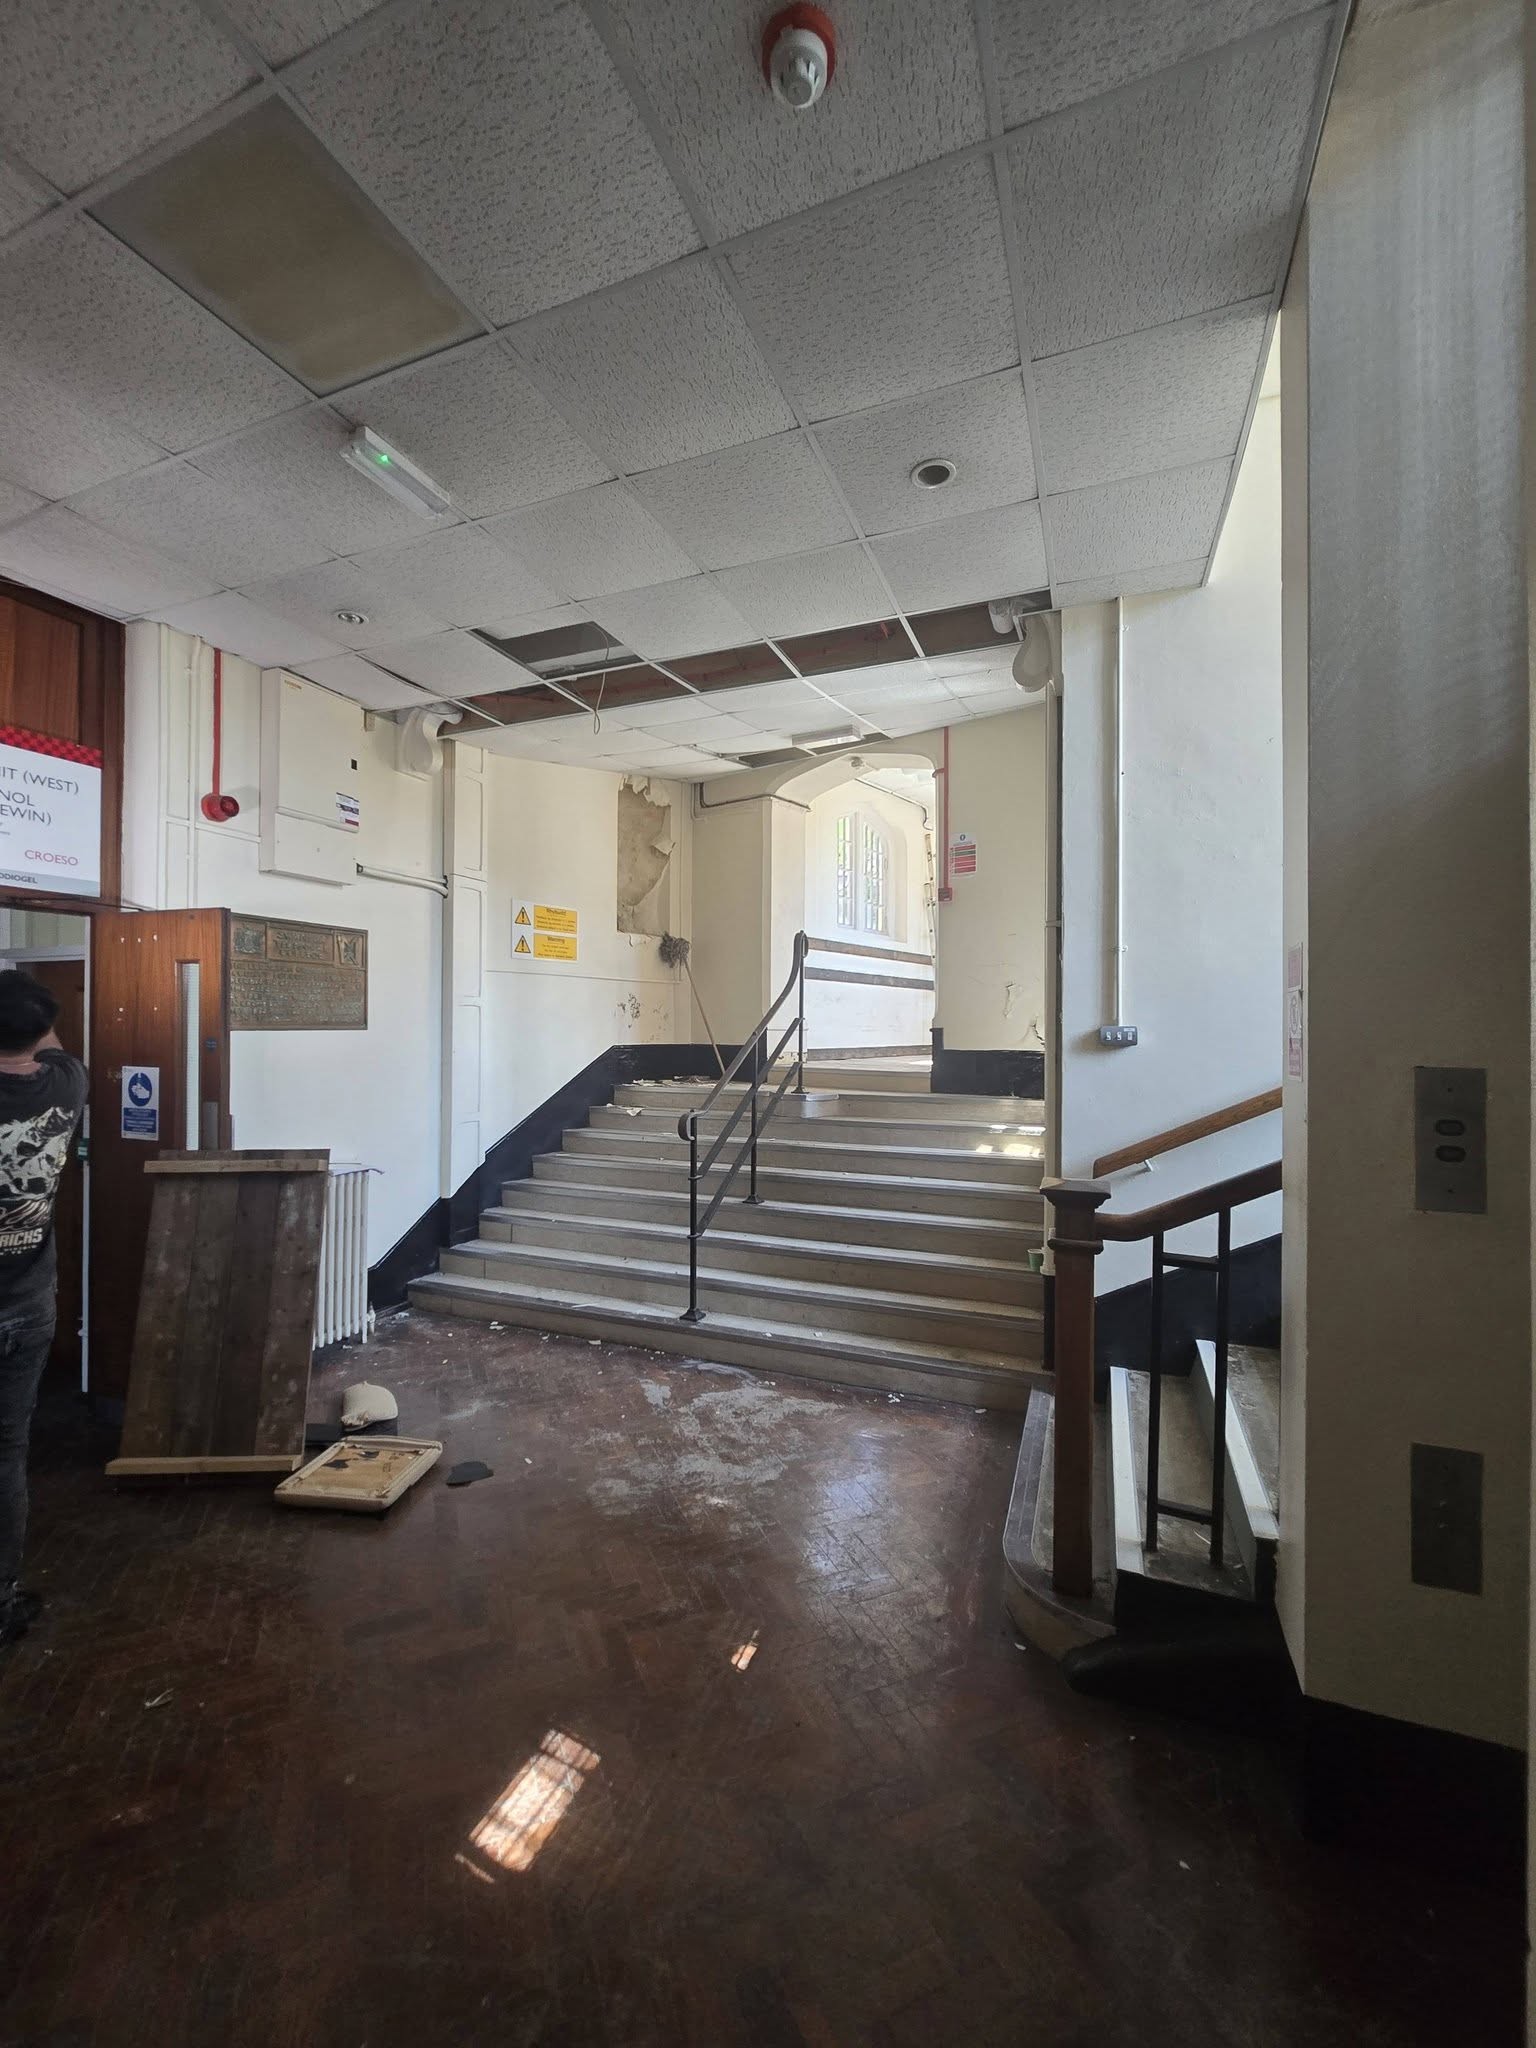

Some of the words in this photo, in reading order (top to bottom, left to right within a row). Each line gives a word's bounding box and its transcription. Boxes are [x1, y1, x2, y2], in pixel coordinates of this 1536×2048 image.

[23, 770, 79, 795] (WEST)
[0, 804, 51, 826] EWIN)
[24, 849, 79, 866] CROESO
